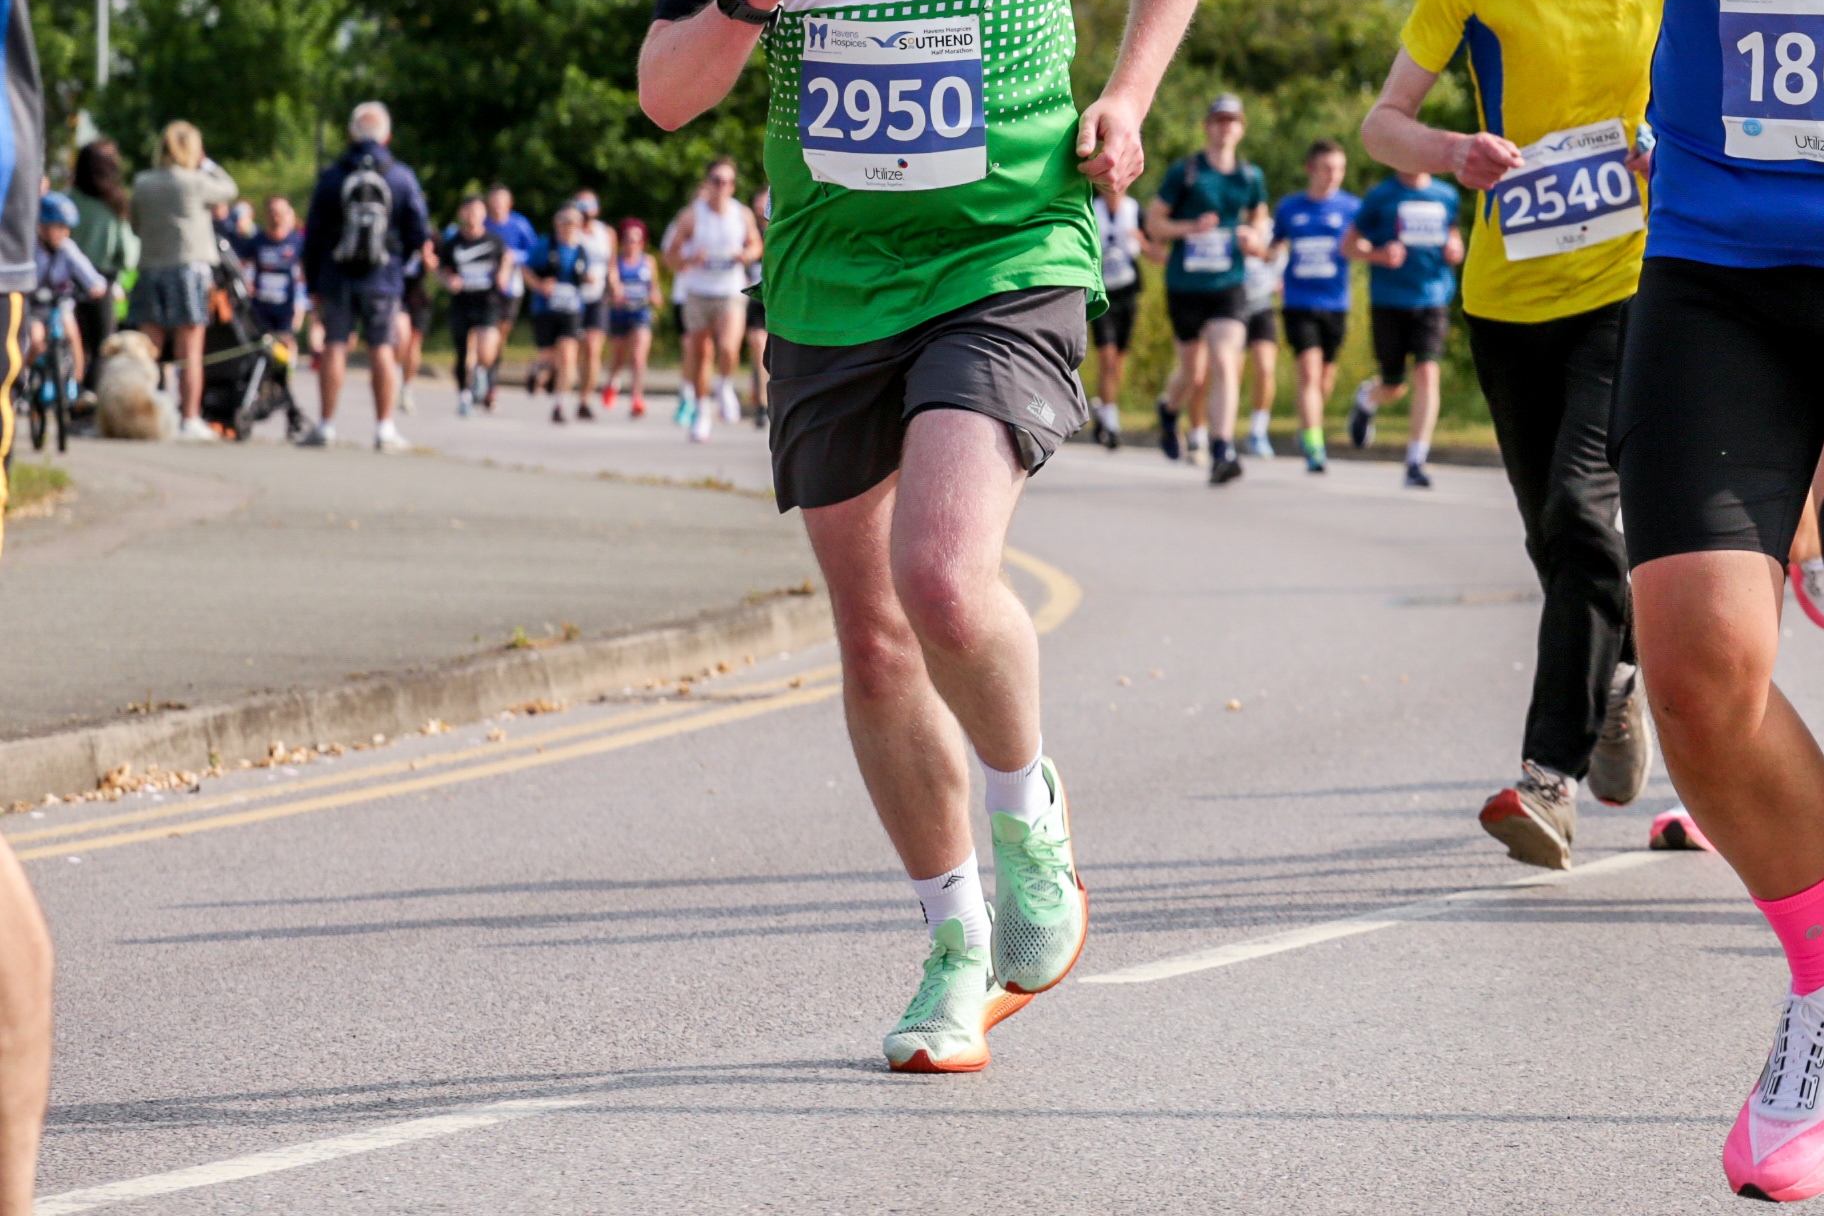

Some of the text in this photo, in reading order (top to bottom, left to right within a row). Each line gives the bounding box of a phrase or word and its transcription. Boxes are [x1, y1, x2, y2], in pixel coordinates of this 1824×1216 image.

[831, 29, 859, 38] Havens
[831, 38, 867, 48] Hospices
[899, 34, 973, 50] SOUTHEND
[807, 76, 973, 141] 2950
[1503, 161, 1631, 228] 2540
